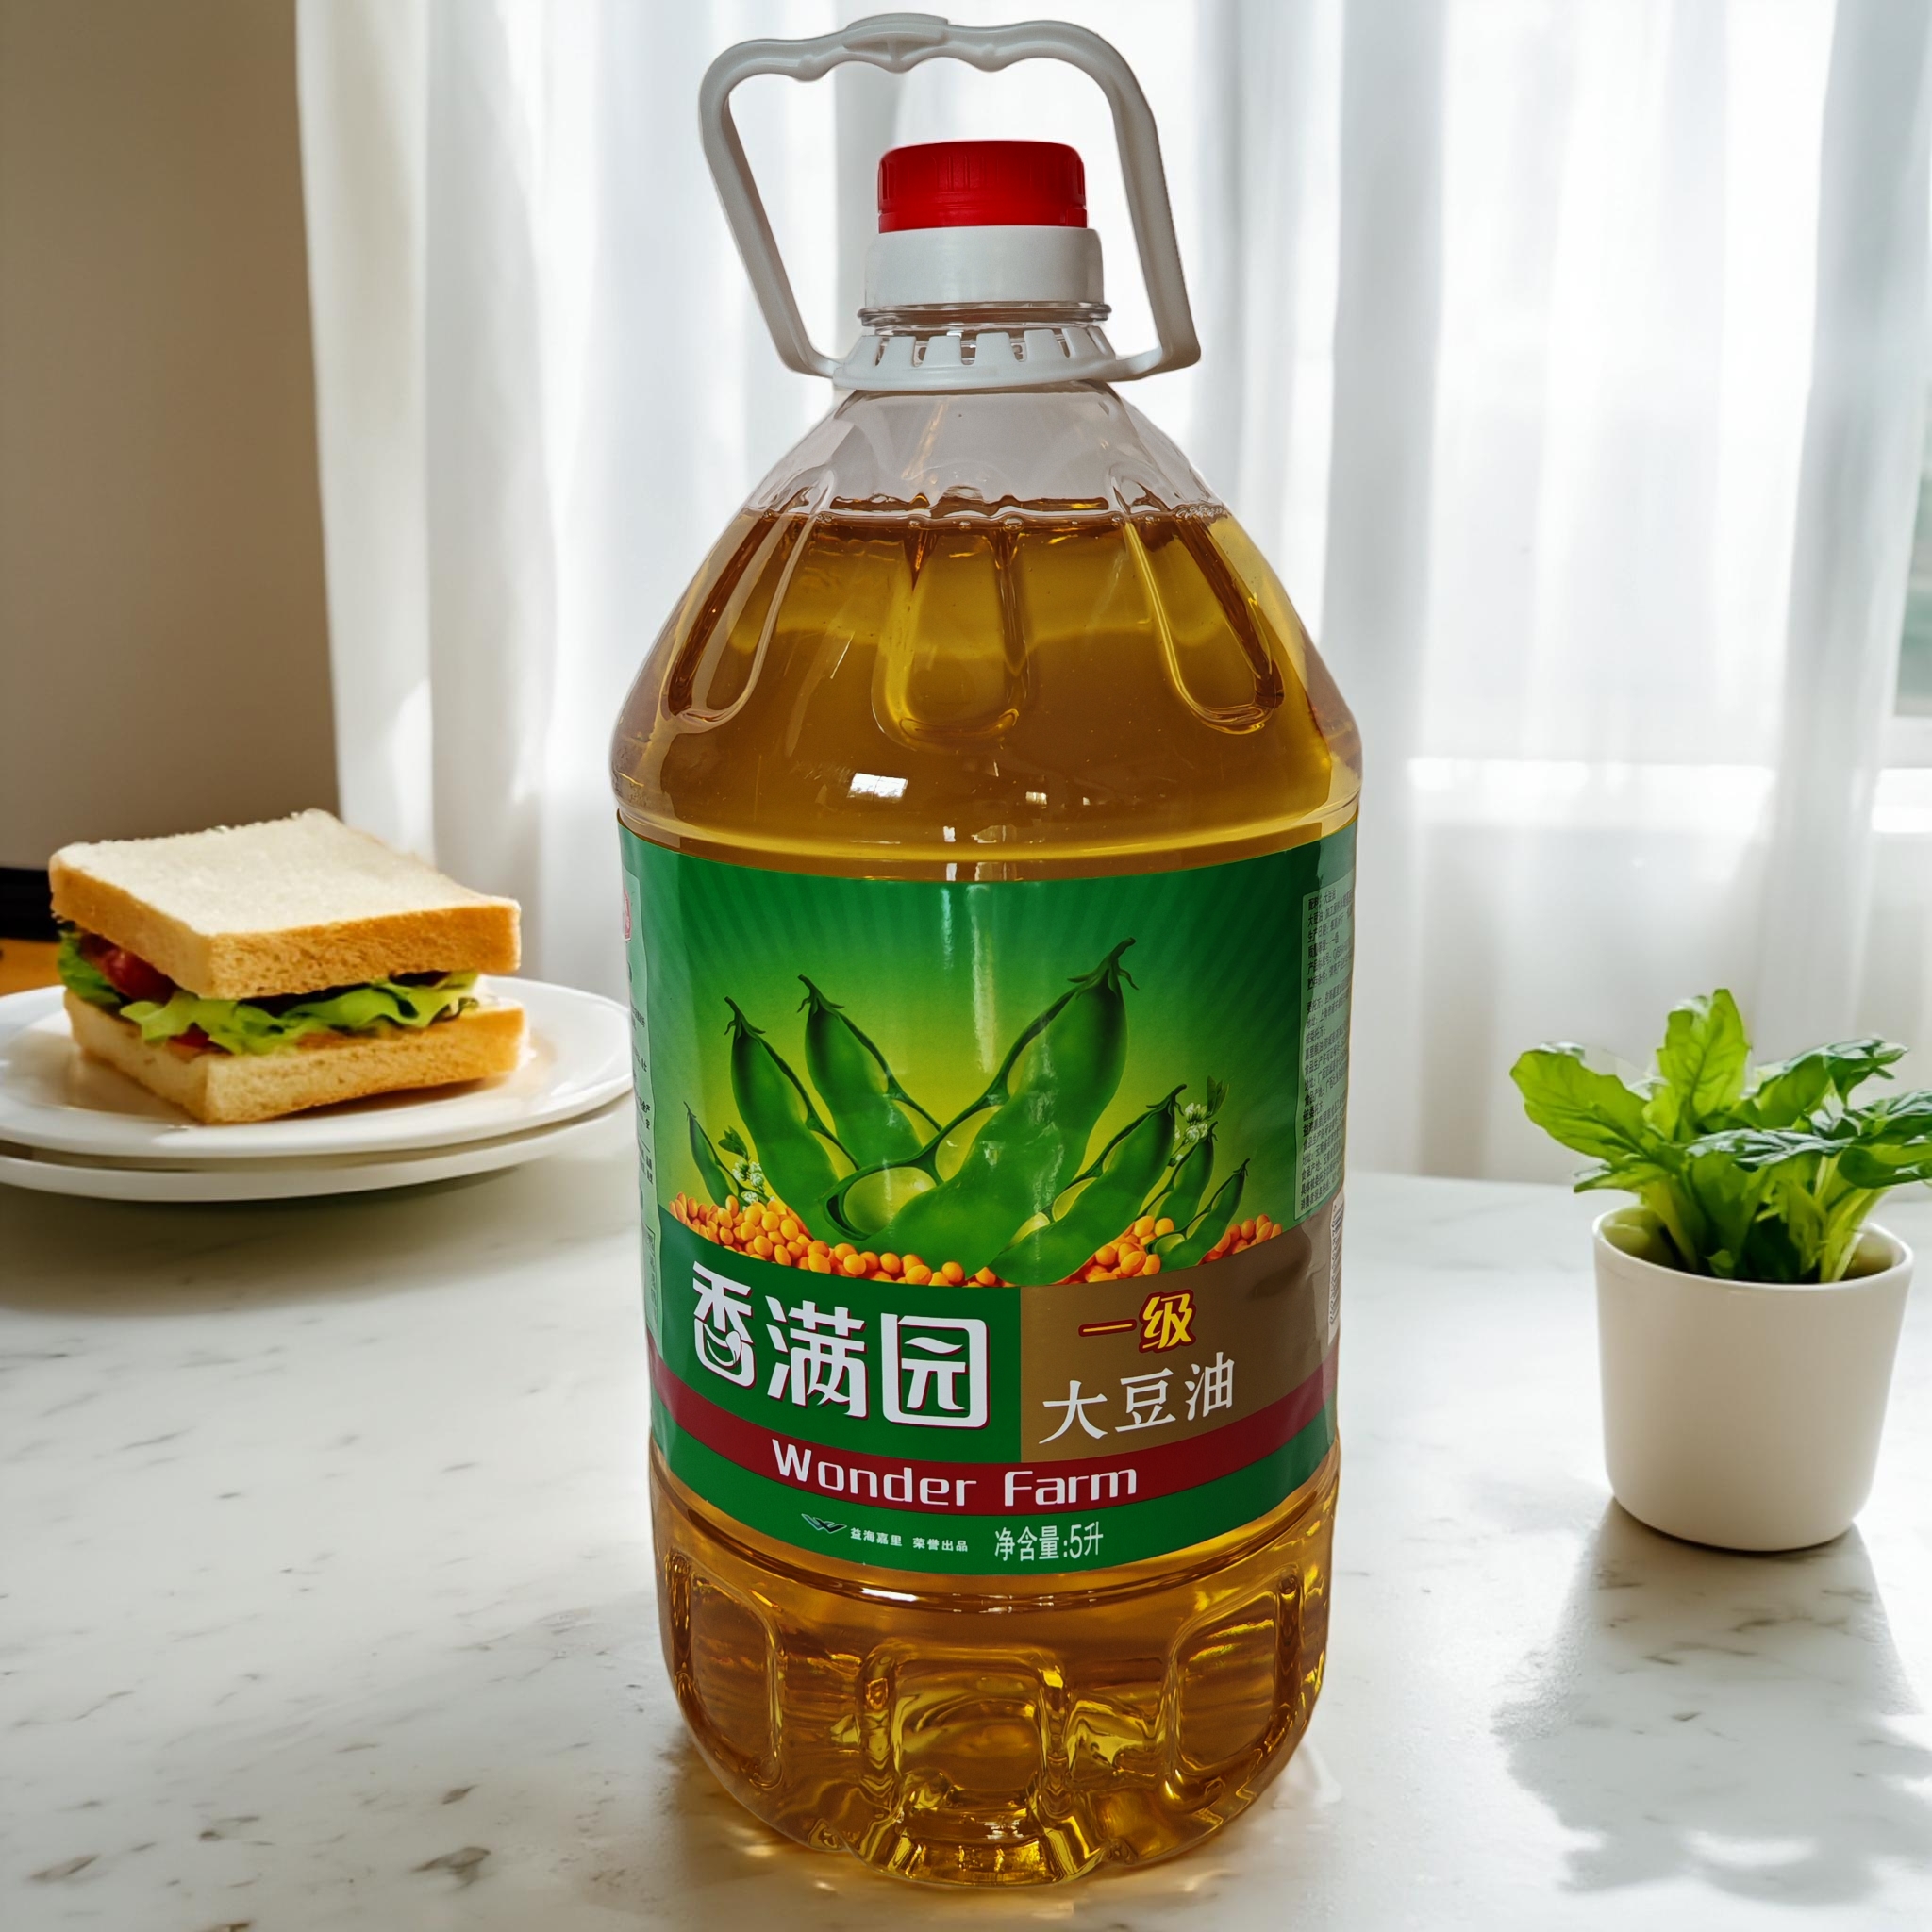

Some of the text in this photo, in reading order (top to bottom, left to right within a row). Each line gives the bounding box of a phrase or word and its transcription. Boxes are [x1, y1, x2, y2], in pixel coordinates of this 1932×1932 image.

[692, 1260, 989, 1429] 香满园
[1082, 1291, 1193, 1350] 一级
[1039, 1351, 1235, 1445] 大豆油
[772, 1438, 1137, 1507] Wonder Farm
[850, 1527, 902, 1547] 益海嘉里
